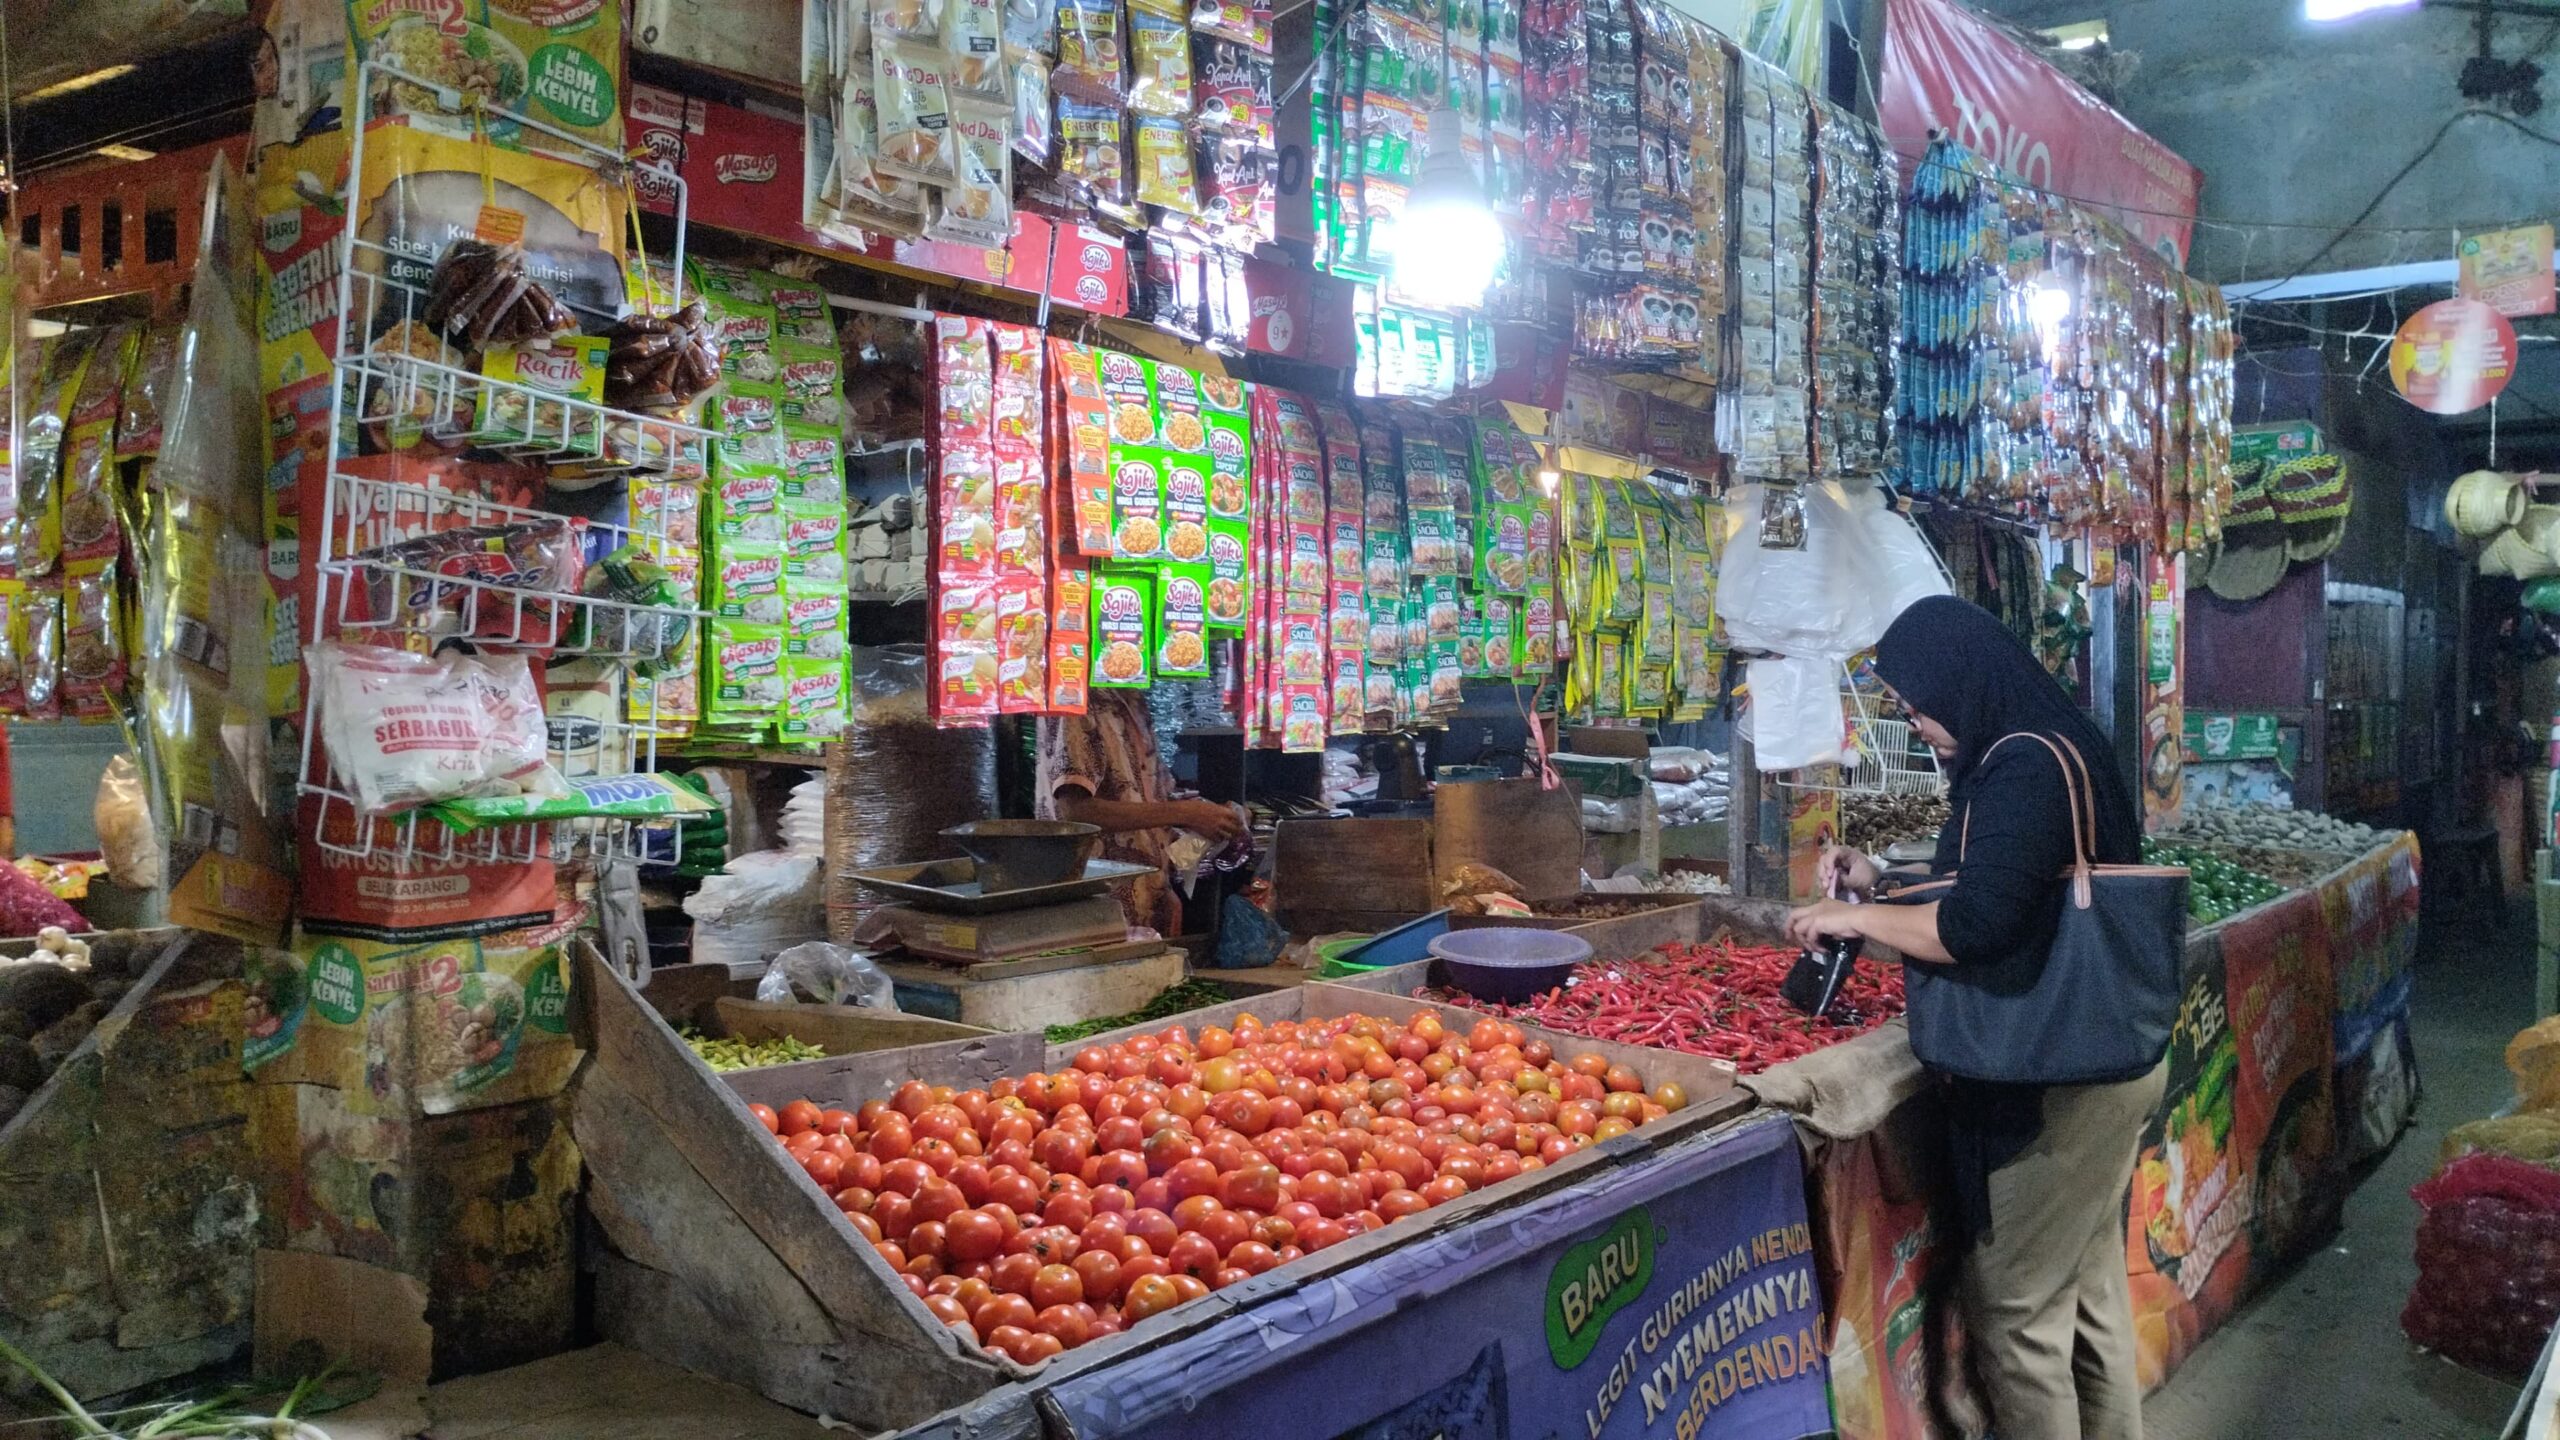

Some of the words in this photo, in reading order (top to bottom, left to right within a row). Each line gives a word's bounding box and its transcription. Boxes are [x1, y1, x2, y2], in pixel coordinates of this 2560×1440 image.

[546, 55, 598, 94] LEBIH
[535, 76, 600, 118] KENYEL
[1066, 120, 1115, 134] ENERGEN
[1953, 94, 2050, 196] TOKO
[1617, 228, 1639, 240] TOP
[1082, 248, 1111, 271] Sajiku
[1077, 278, 1106, 302] Sajiku
[515, 352, 583, 380] Racik
[1103, 356, 1144, 383] Sajiku
[1157, 365, 1196, 392] Sajiku
[1210, 431, 1244, 460] Sajiku
[720, 474, 777, 500] Masako
[1115, 468, 1157, 496] Sajiku
[1168, 473, 1205, 501] Sajiku
[787, 516, 840, 541] Masako
[1337, 529, 1358, 540] SAORI
[1416, 525, 1439, 536] SAORI
[1210, 537, 1244, 565] Sajiku
[1296, 538, 1317, 551] SAORI
[722, 556, 779, 582] Masako
[1101, 593, 1141, 621] Sajiku
[1167, 583, 1202, 611] Sajiku
[1339, 597, 1359, 607] SAORI
[1290, 629, 1314, 641] SAORI
[720, 637, 779, 665] Masako
[1339, 665, 1358, 676] SAORI
[788, 671, 840, 700] Masako
[1292, 699, 1316, 712] SAORI
[430, 956, 463, 998] 2
[312, 979, 357, 1013] KENYEL
[1561, 1228, 1639, 1333] BARU
[1586, 1338, 1636, 1439] LEGIT
[1641, 1245, 1749, 1354] GURIHNYA
[1640, 1268, 1811, 1426] NYEMEKNYA
